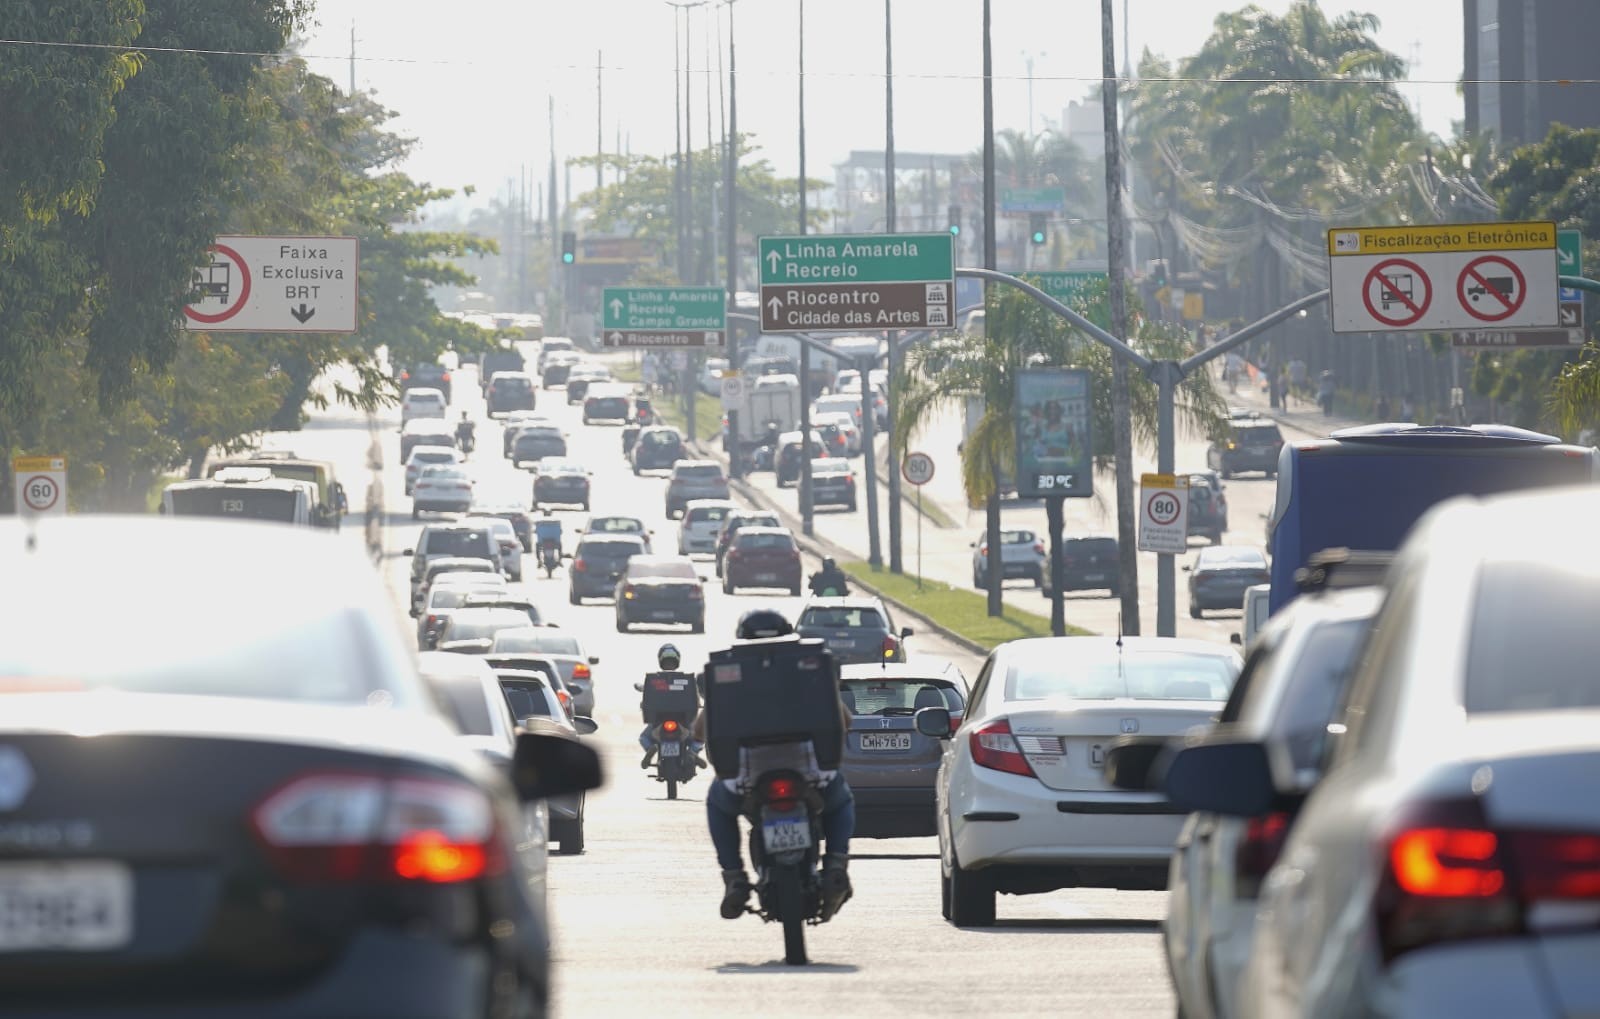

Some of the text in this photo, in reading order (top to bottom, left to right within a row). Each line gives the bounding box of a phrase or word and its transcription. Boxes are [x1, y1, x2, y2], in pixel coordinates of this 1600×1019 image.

[1363, 231, 1549, 249] Fiscalização Eletrônica
[280, 245, 327, 259] Faixa
[785, 241, 918, 258] Linha Amarela
[263, 265, 344, 280] Exclusiva
[785, 262, 858, 278] Recreio
[285, 285, 321, 299] BRT
[628, 291, 719, 302] Linha Amarela
[786, 290, 880, 306] Riocentro
[629, 304, 676, 314] Recreio
[629, 315, 720, 329] Campo Grande
[787, 309, 921, 325] Cidade das Artes
[627, 334, 689, 345] Riocentro
[911, 459, 927, 473] 80
[1038, 474, 1055, 489] 30
[31, 484, 52, 498] 60
[1154, 500, 1175, 514] 80
